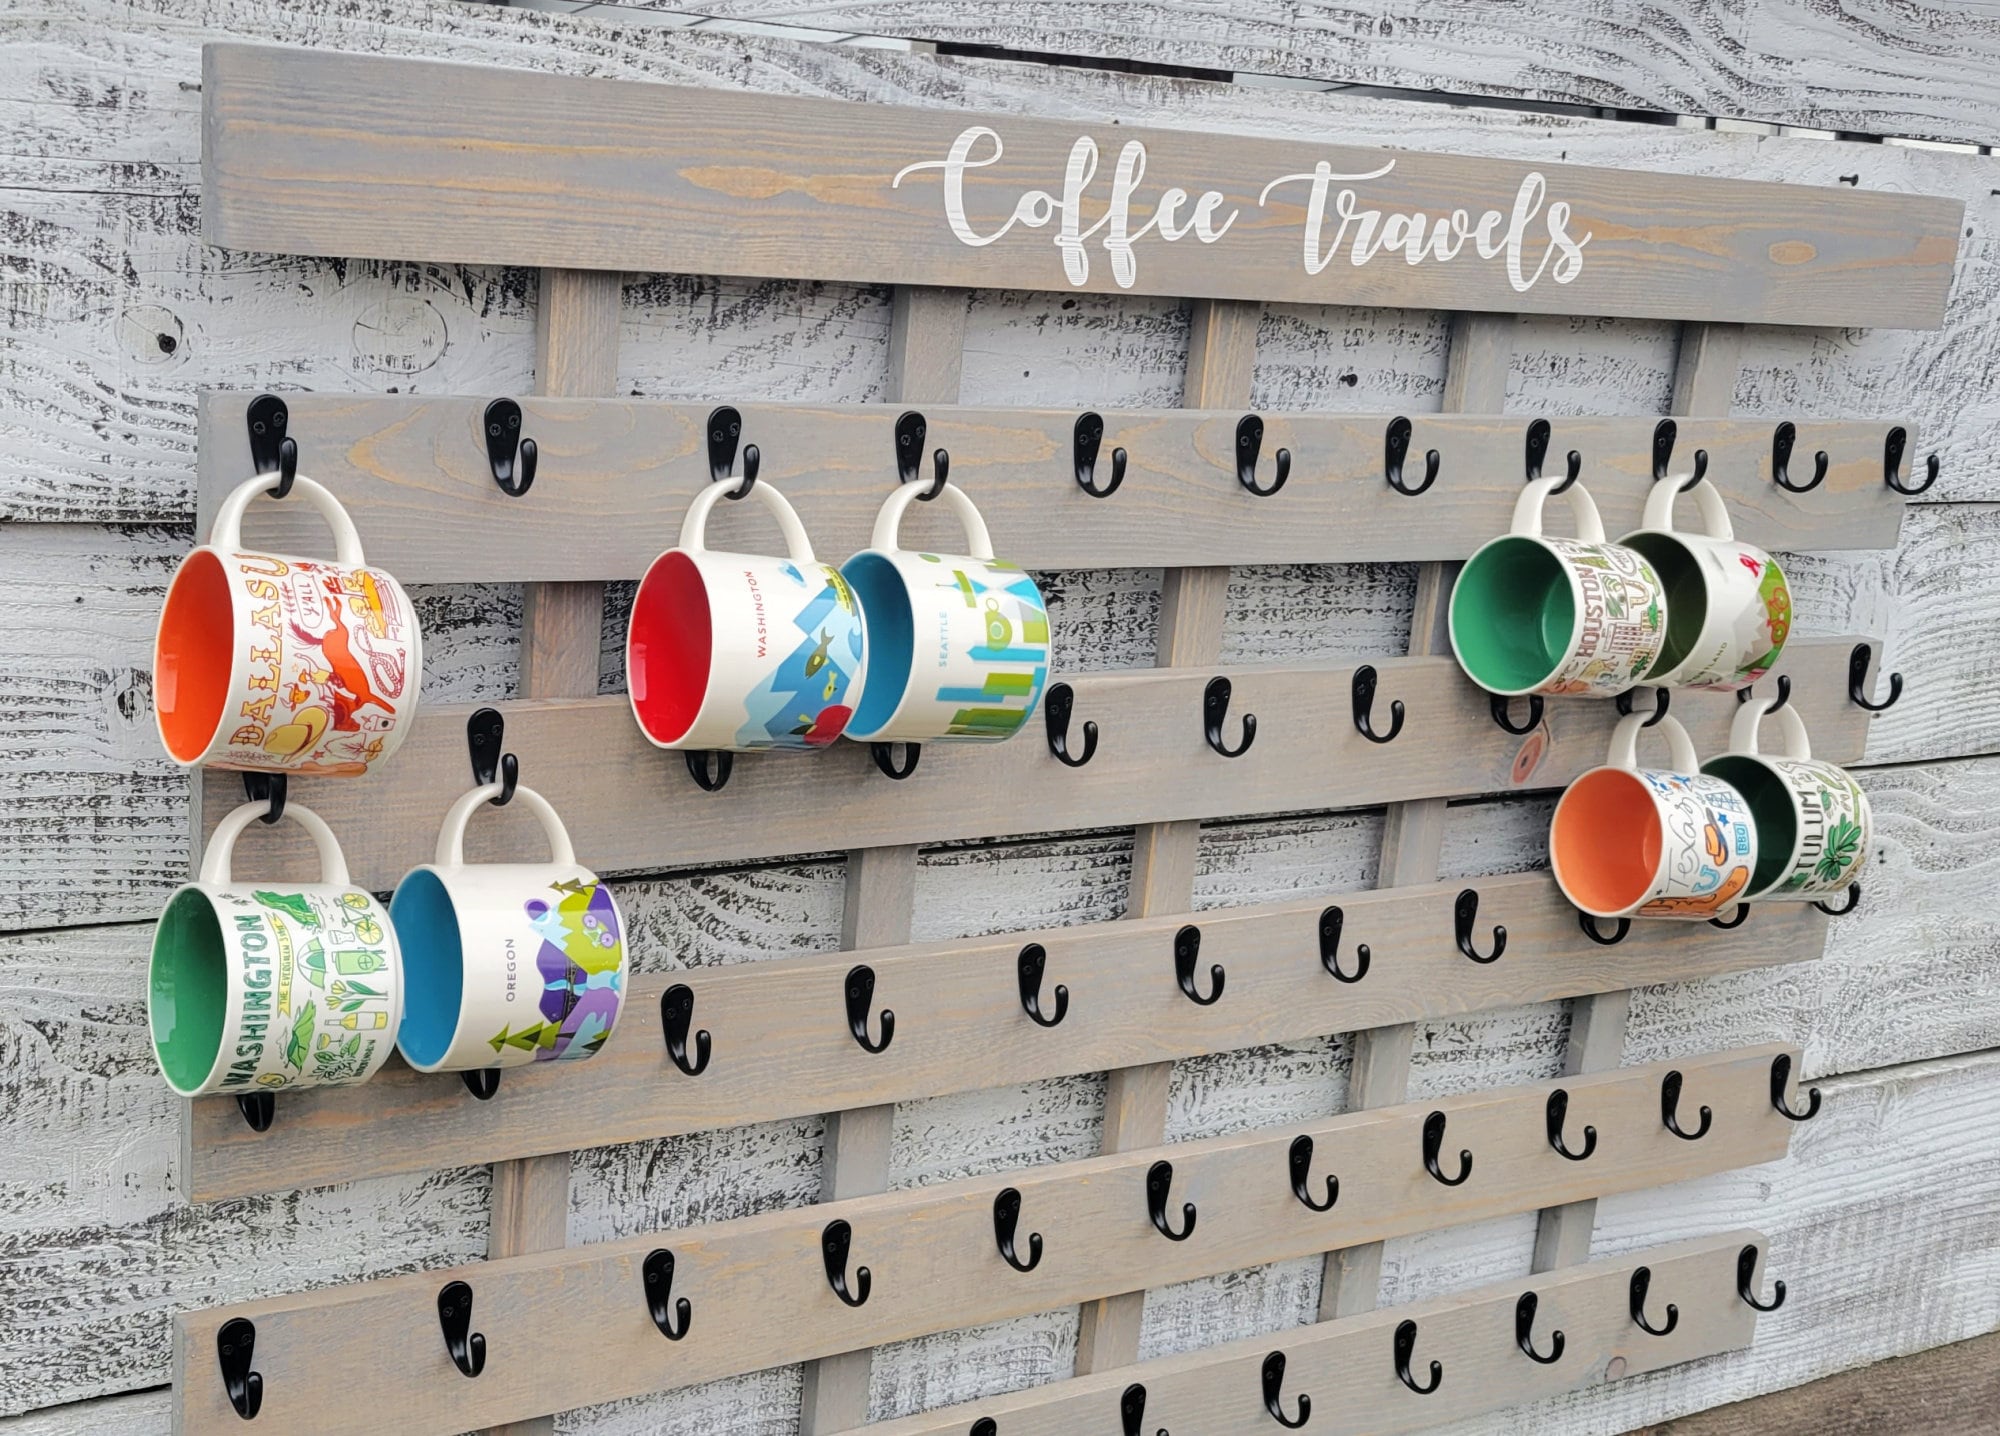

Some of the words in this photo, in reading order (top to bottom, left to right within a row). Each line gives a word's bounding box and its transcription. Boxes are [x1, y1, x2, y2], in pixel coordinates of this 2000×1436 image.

[893, 126, 1239, 288] Coffee
[298, 583, 320, 617] Y'ALL
[744, 571, 767, 657] WASHINGTON
[938, 611, 949, 667] SEATTLE
[1575, 566, 1604, 659] HOUSTON
[229, 579, 283, 747] DALLAS
[1666, 796, 1705, 893] Texas
[1793, 790, 1825, 874] TULUM
[219, 914, 273, 1088] WASHINGTON
[279, 991, 288, 1005] THE
[505, 938, 516, 1002] OREGON
